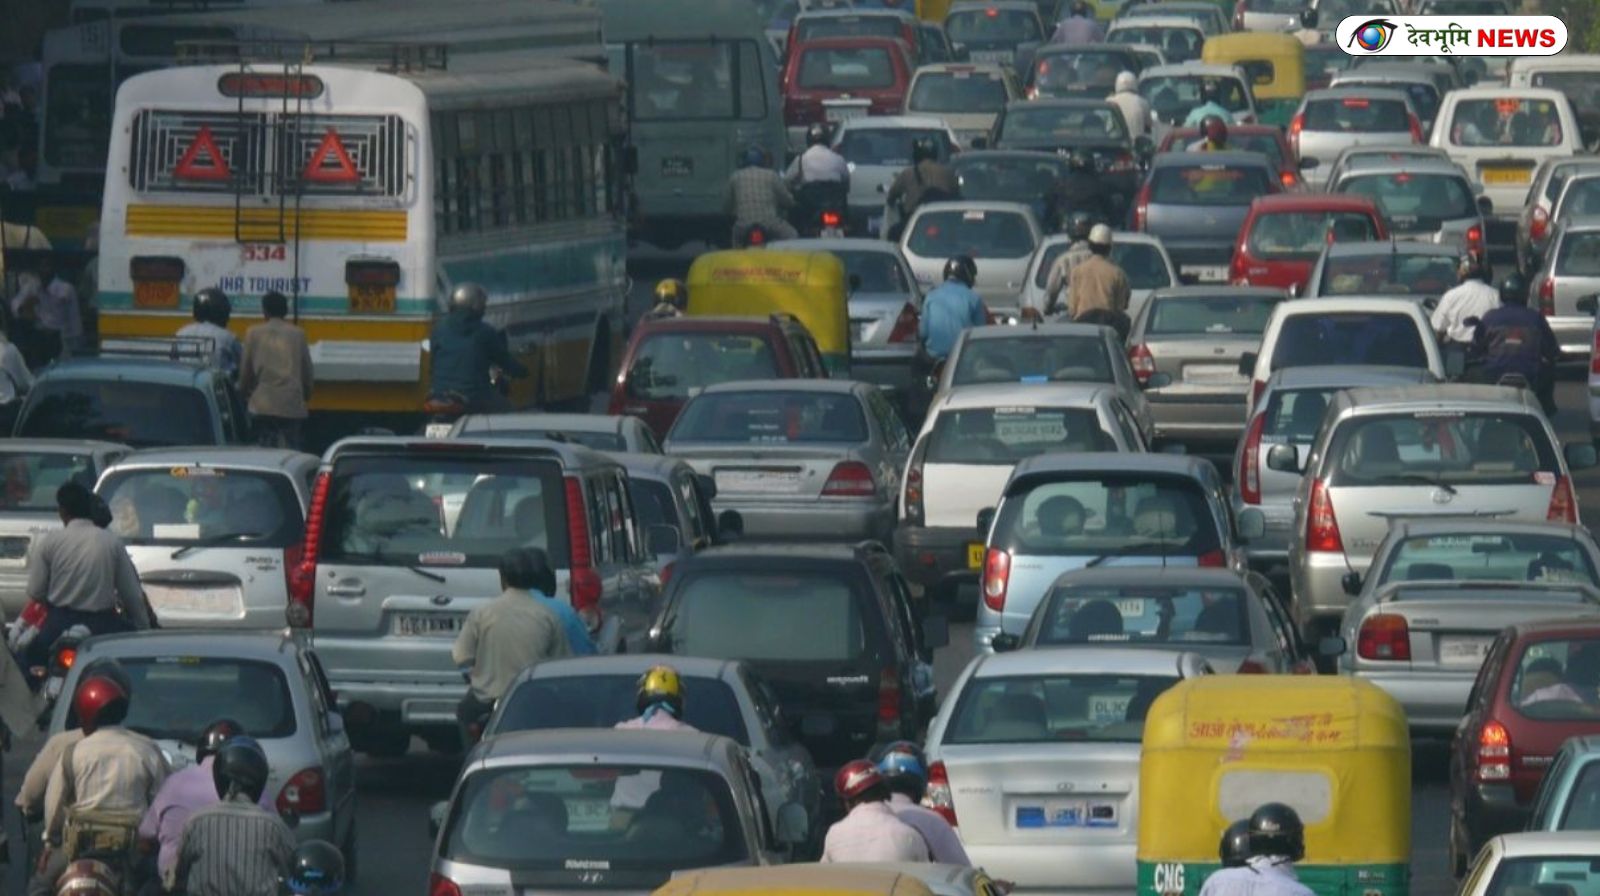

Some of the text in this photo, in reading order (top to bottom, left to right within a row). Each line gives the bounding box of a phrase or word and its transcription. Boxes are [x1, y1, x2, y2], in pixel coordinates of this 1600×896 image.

[243, 245, 286, 261] 534
[247, 276, 312, 292] TOURIST
[1154, 862, 1185, 894] CNG
